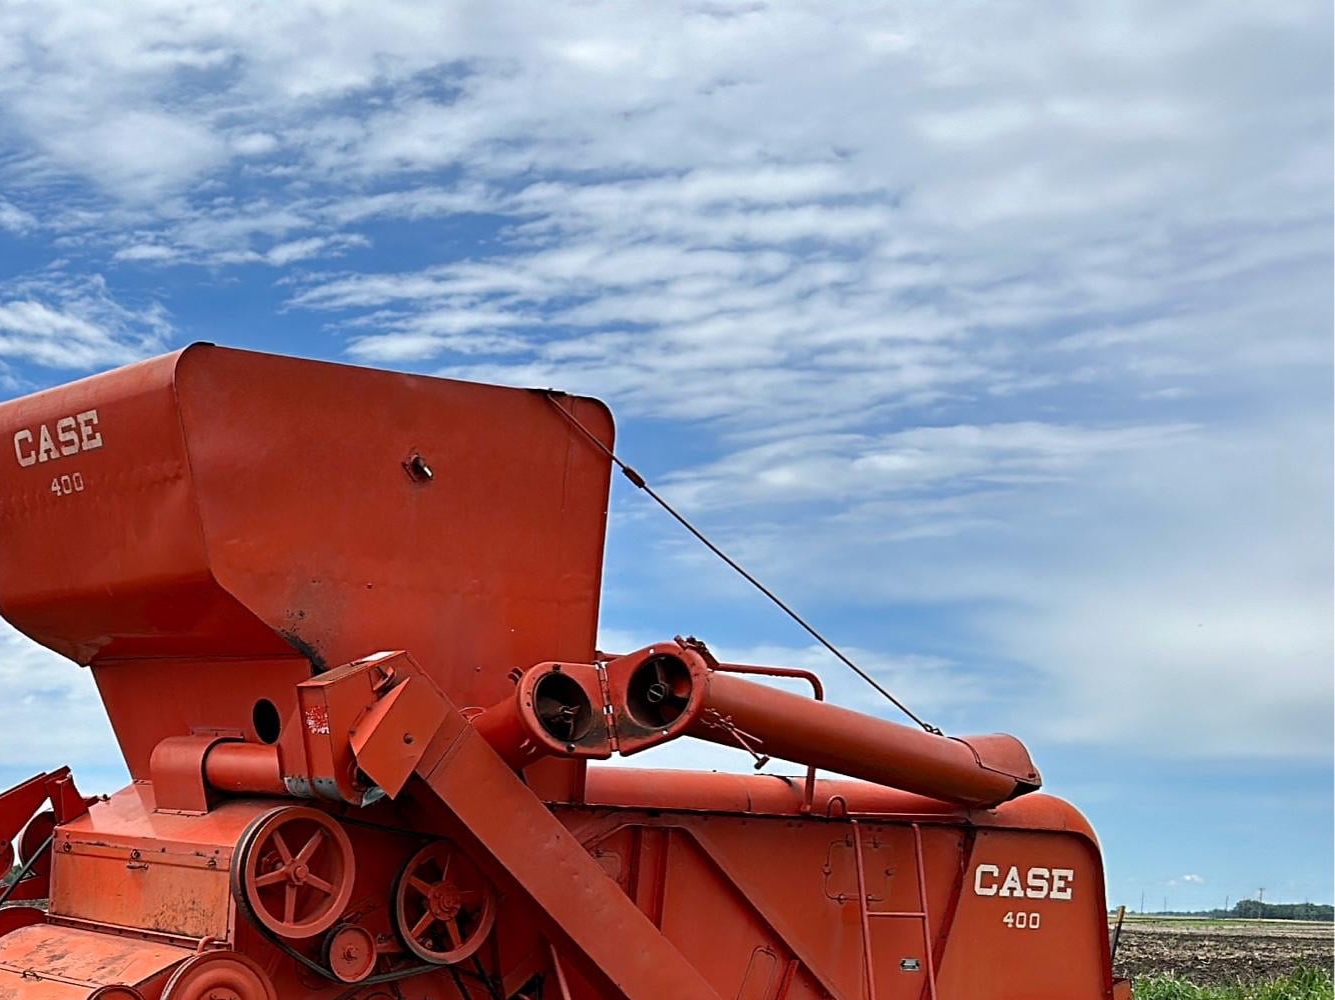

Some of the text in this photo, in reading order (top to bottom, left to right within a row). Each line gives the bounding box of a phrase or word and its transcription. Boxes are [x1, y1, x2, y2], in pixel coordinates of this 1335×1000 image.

[14, 409, 103, 467] CASE
[51, 472, 84, 496] 400
[974, 864, 1074, 899] CASE
[1002, 911, 1040, 929] 400
